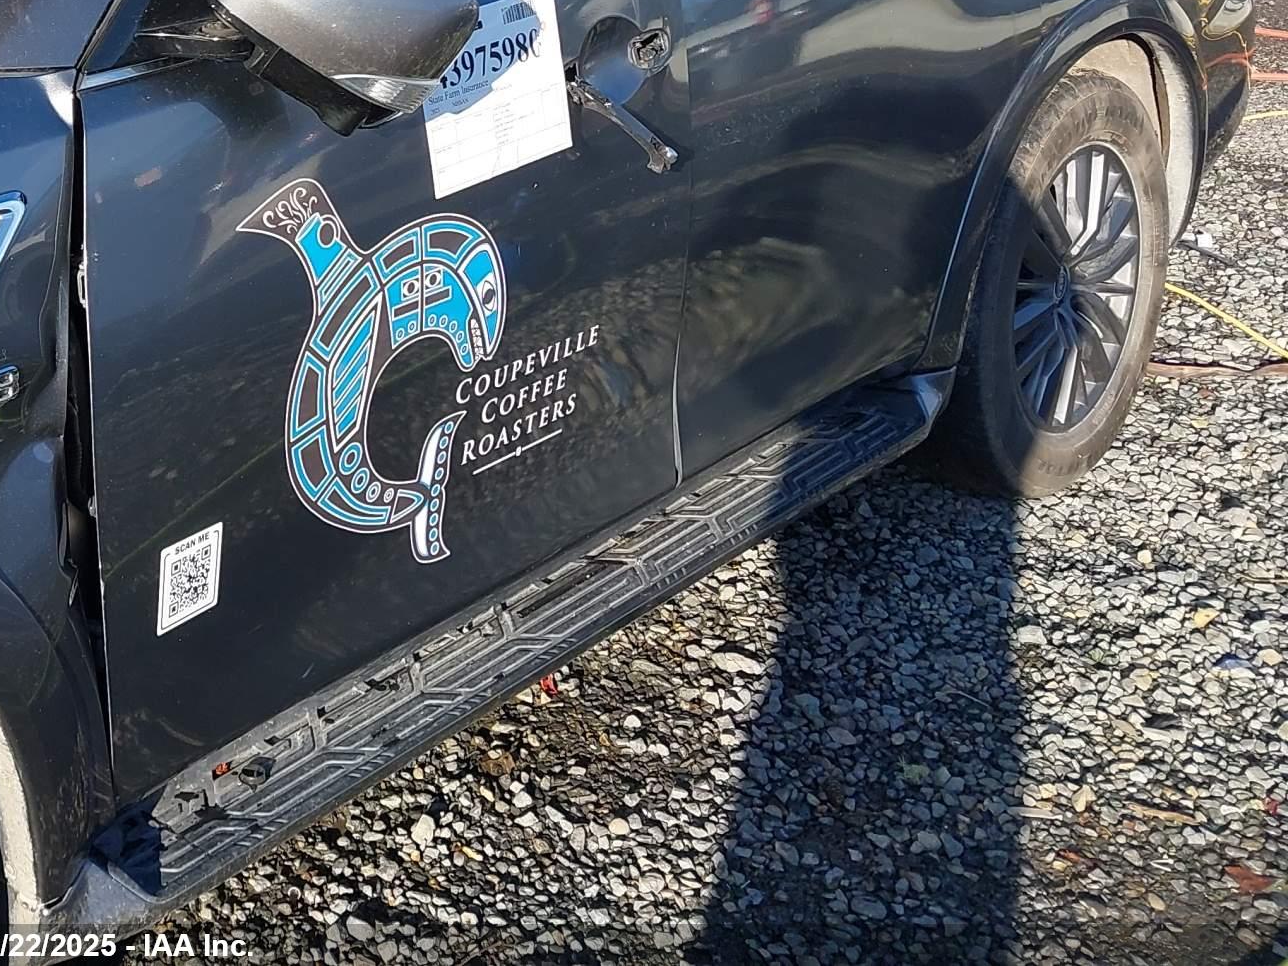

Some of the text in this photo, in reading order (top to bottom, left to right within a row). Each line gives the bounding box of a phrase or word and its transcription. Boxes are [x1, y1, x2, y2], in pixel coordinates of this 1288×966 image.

[455, 324, 600, 405] COUPEVILLE
[481, 368, 568, 424] COFFEE
[461, 392, 577, 466] ROASTERS
[174, 531, 210, 555] SCAN ME
